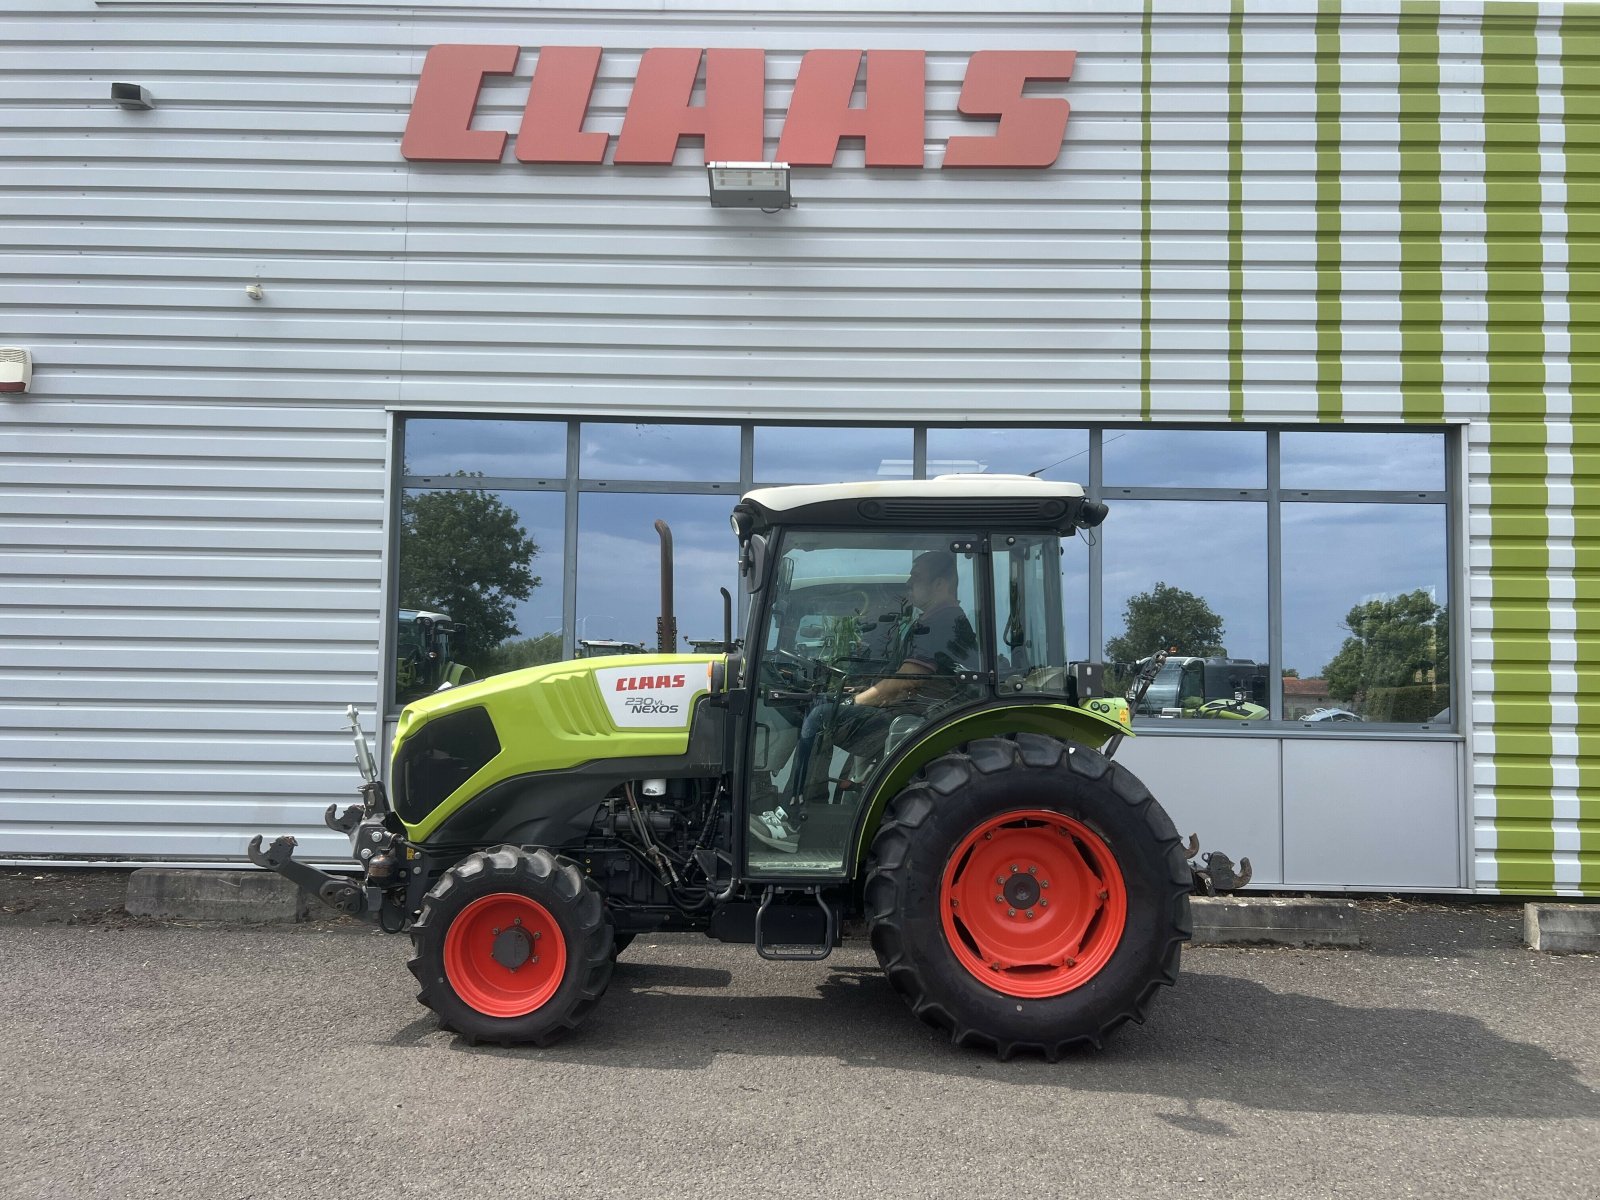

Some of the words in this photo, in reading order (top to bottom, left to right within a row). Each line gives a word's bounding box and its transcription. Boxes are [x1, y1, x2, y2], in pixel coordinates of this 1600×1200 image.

[401, 44, 1077, 169] CLAAS
[615, 674, 685, 692] CLAAS
[631, 705, 678, 714] NEXOS
